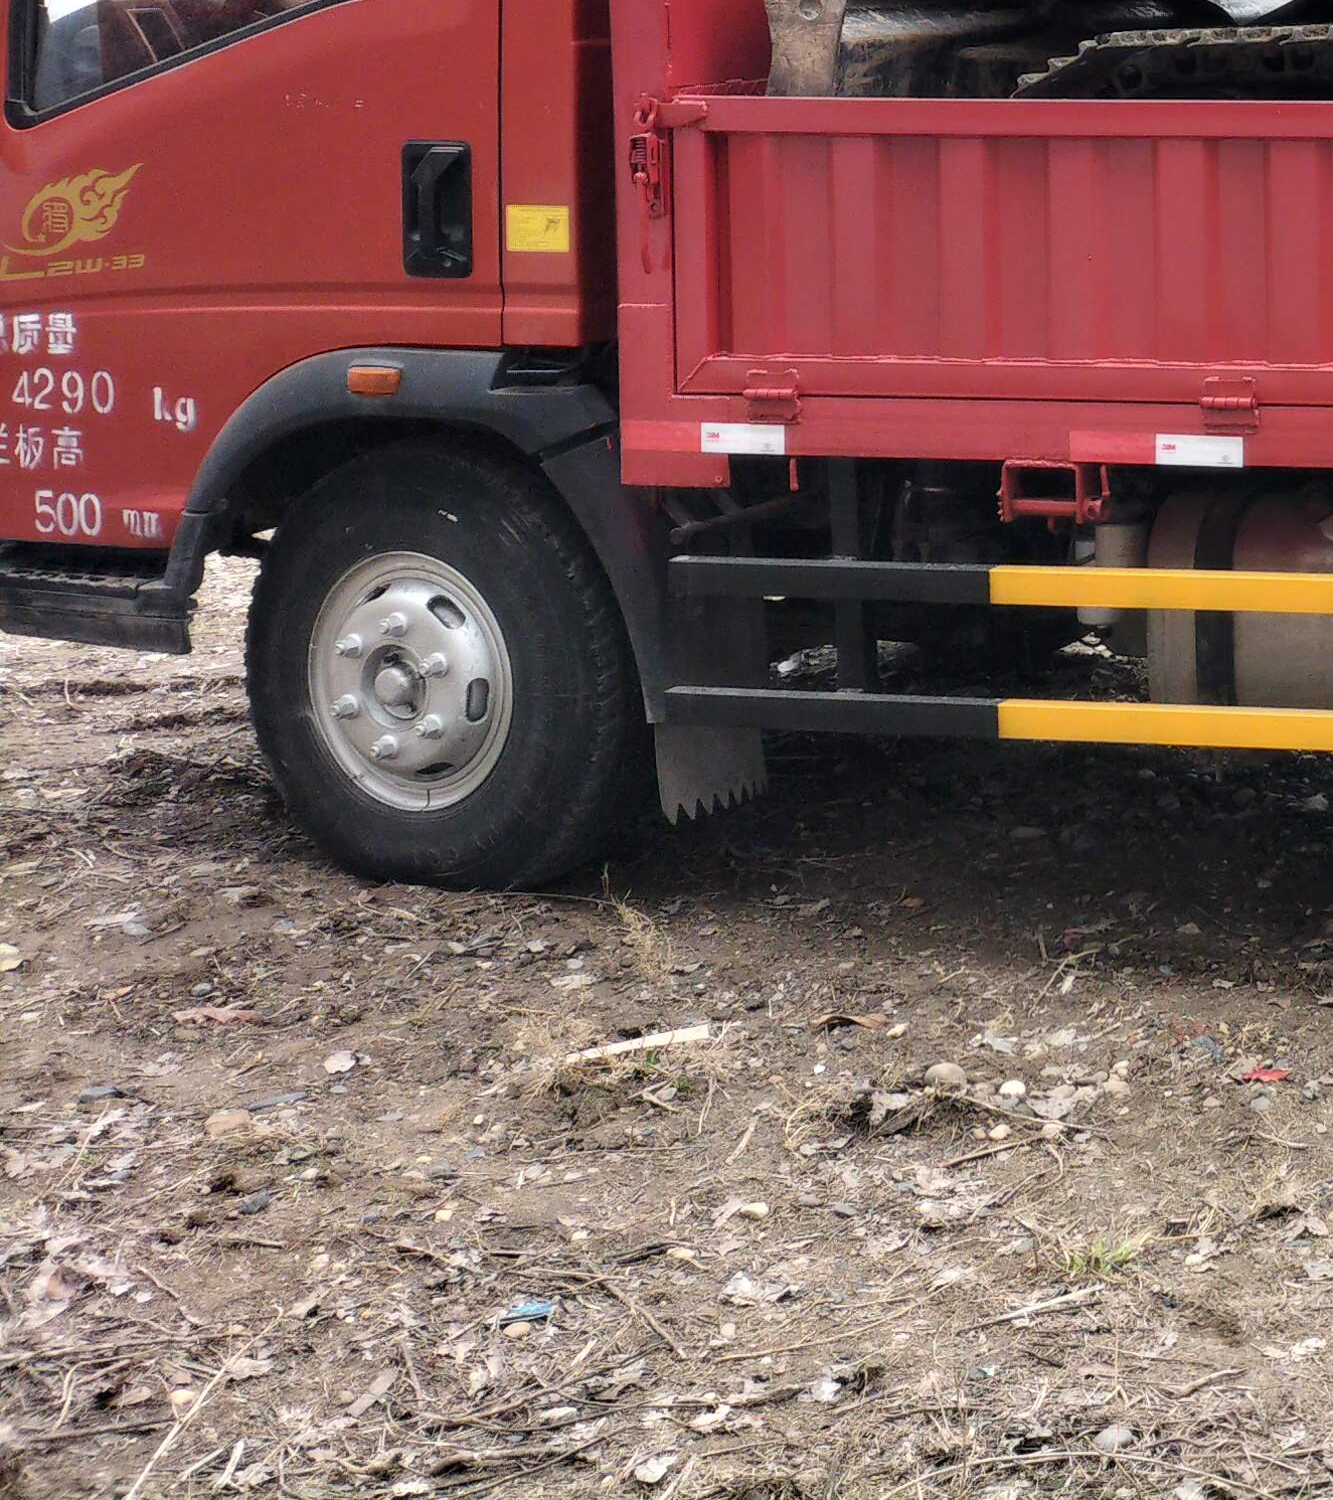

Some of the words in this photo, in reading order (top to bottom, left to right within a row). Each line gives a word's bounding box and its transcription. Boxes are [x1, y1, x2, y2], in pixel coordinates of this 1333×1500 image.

[0, 313, 76, 354] 质量
[12, 367, 114, 414] 4290
[35, 489, 101, 536] 500
